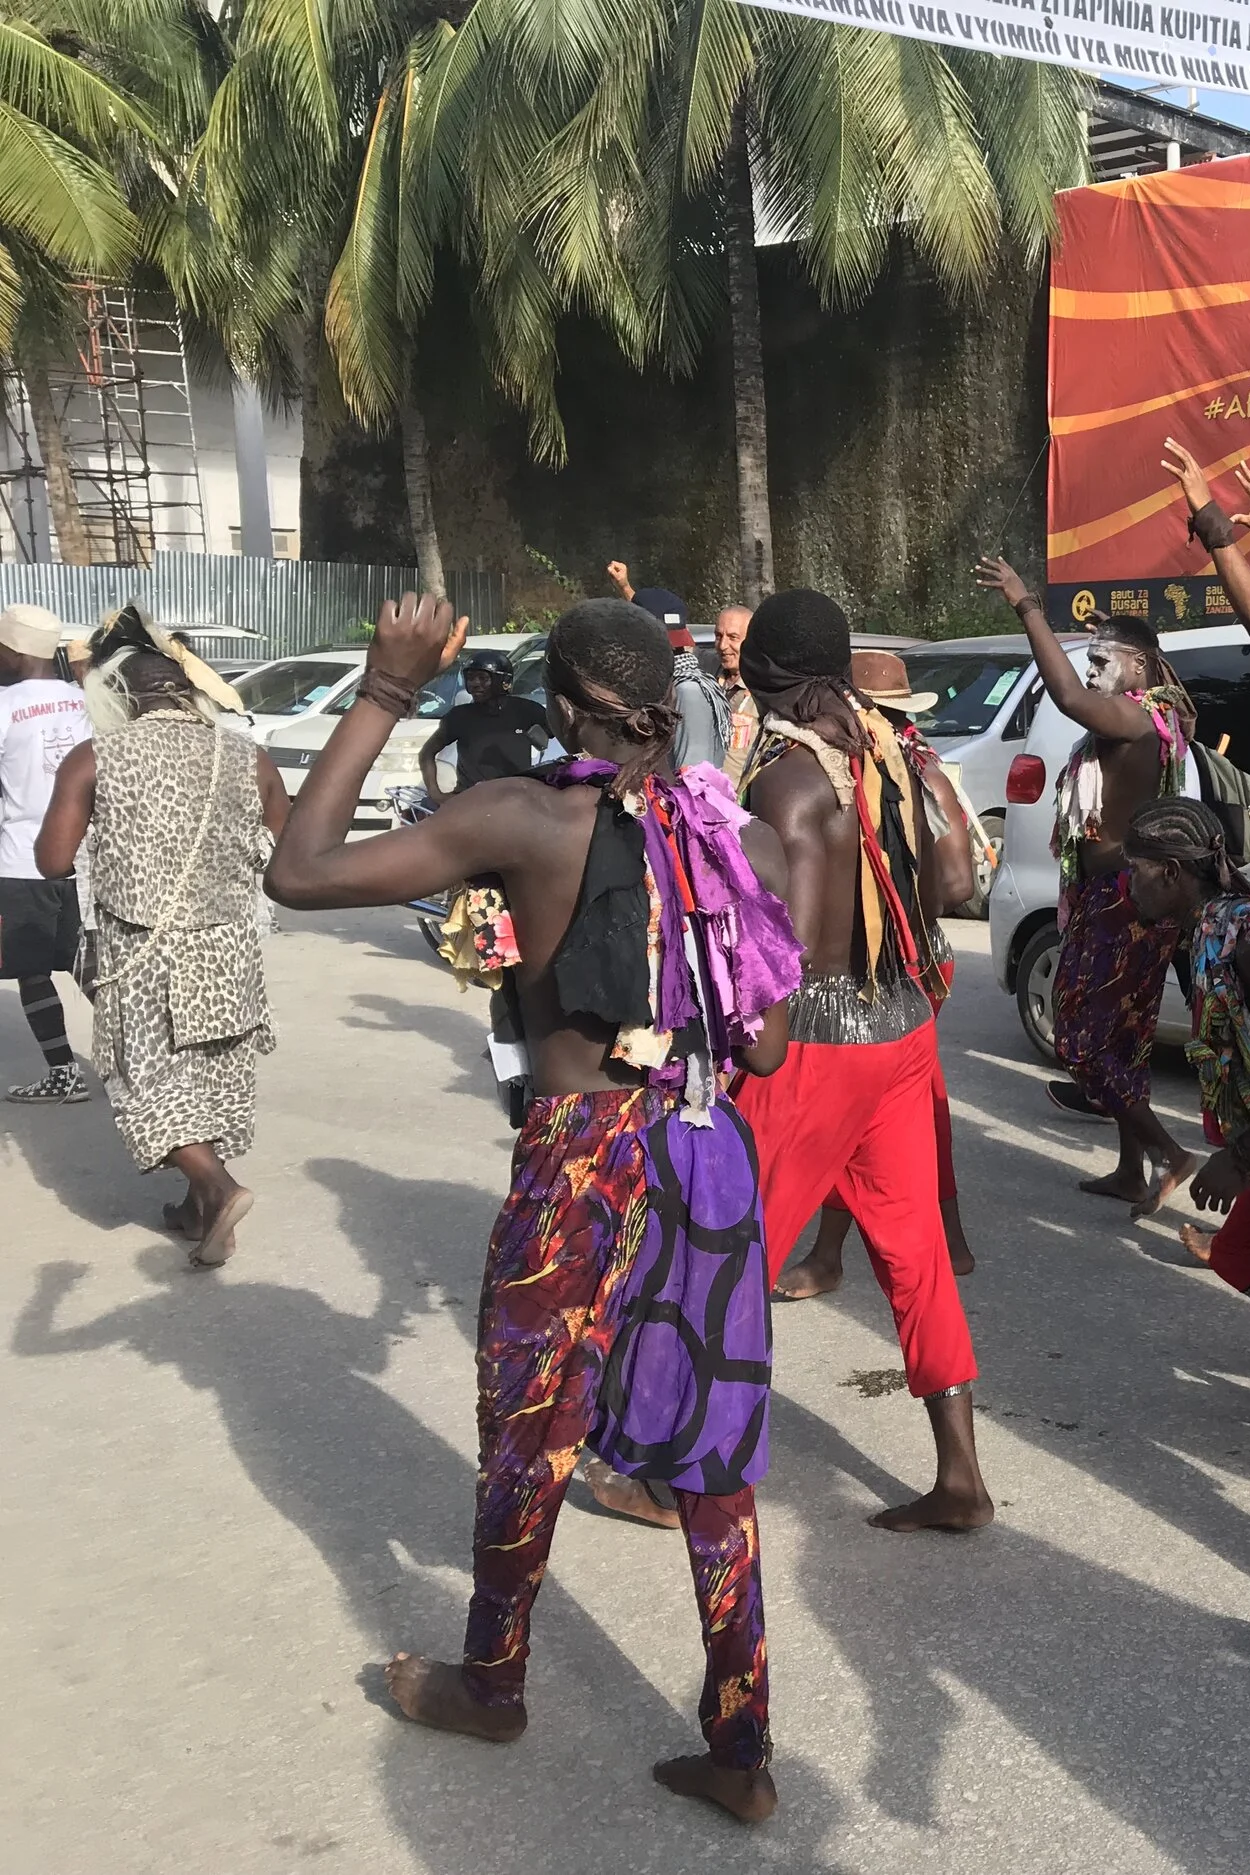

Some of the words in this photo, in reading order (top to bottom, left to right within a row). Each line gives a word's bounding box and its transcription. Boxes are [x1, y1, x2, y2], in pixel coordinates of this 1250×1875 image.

[1161, 6, 1241, 50] KUPITIA
[908, 3, 954, 37] WA
[955, 12, 1062, 56] VYOMBO
[1063, 33, 1112, 66] VYA
[1113, 42, 1177, 78] MOTO
[1180, 55, 1249, 90] NDANI
[1110, 590, 1134, 600] sauti
[1138, 589, 1149, 599] za
[1110, 598, 1149, 610] busara
[11, 702, 56, 723] KILIMANI
